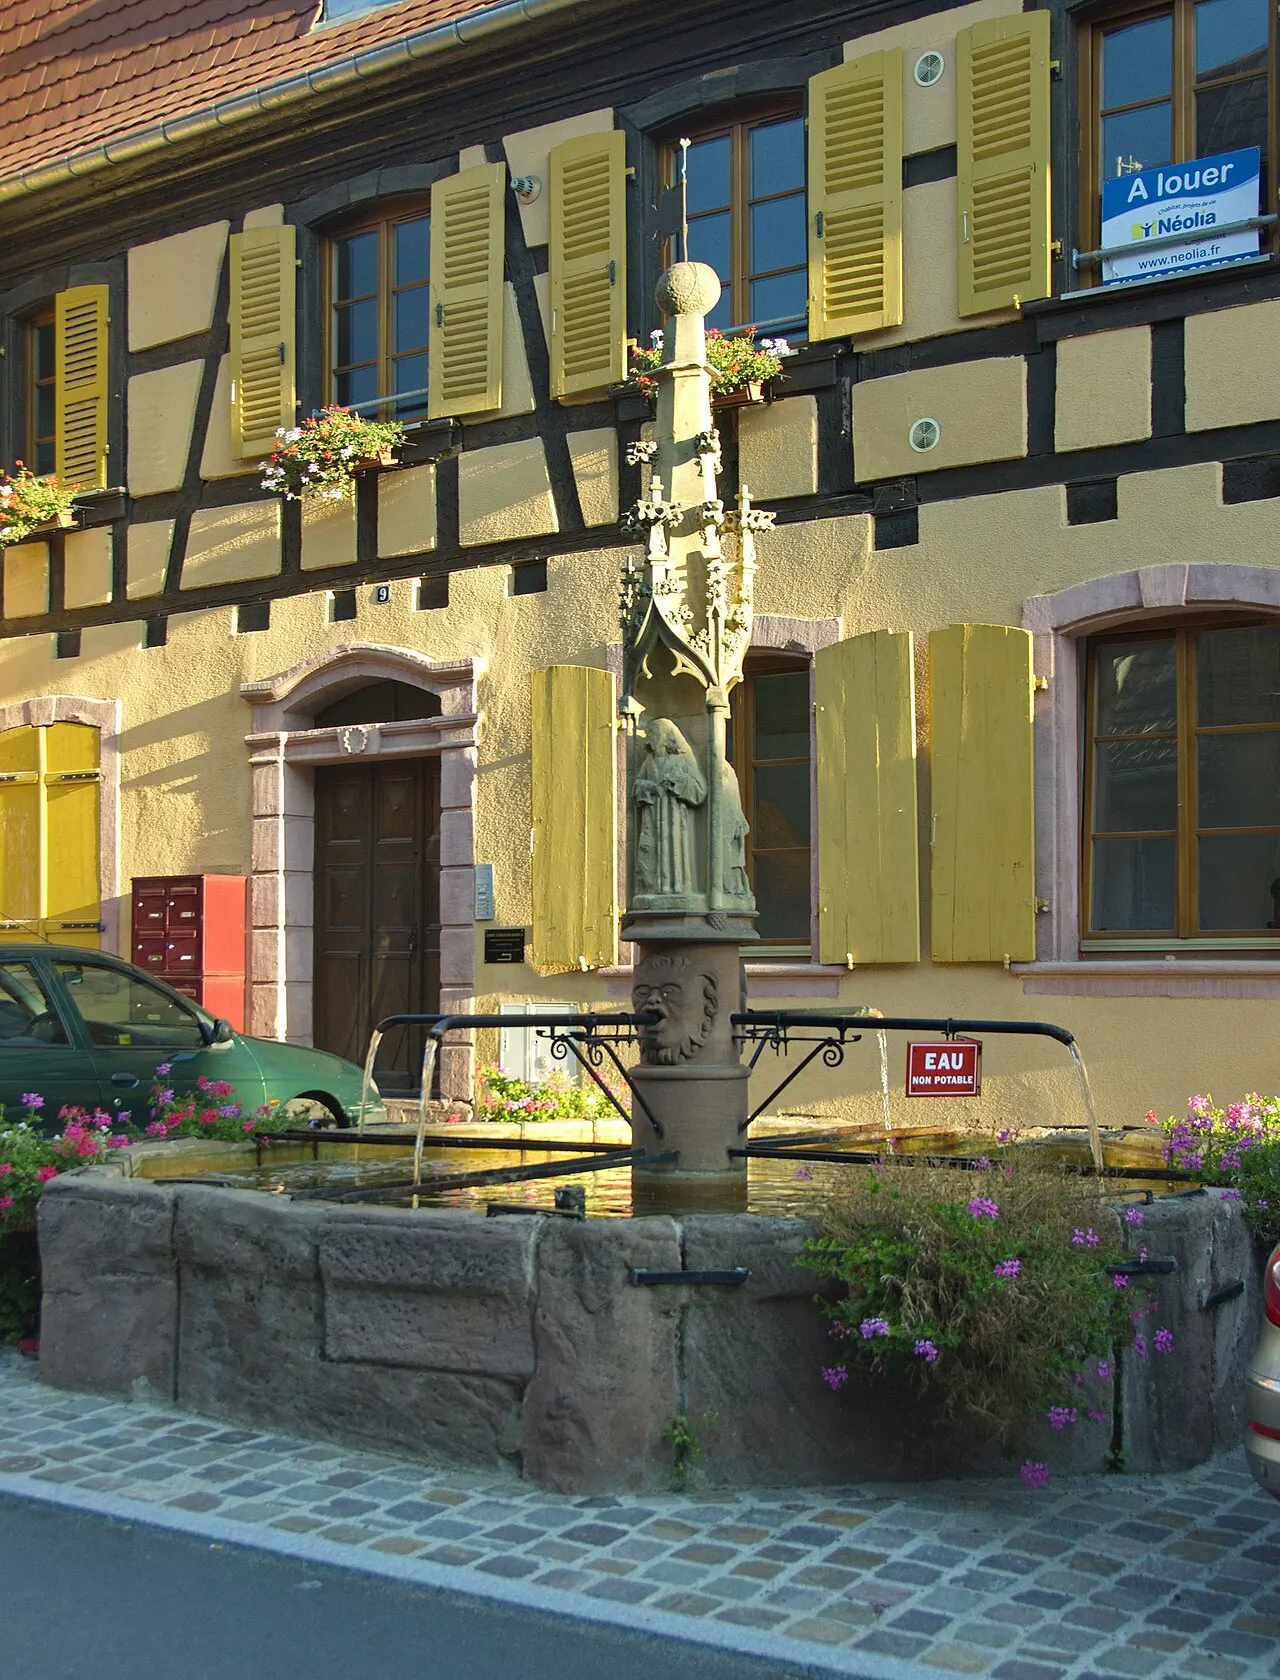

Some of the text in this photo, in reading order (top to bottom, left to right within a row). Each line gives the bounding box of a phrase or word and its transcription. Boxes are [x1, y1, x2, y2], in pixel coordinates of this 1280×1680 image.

[1127, 163, 1234, 203] A louer
[1158, 209, 1216, 235] Néolia
[1138, 245, 1221, 270] www.neolia.fr
[380, 588, 386, 600] 9
[925, 1052, 964, 1070] EAU
[912, 1075, 974, 1085] NON POTABLE
